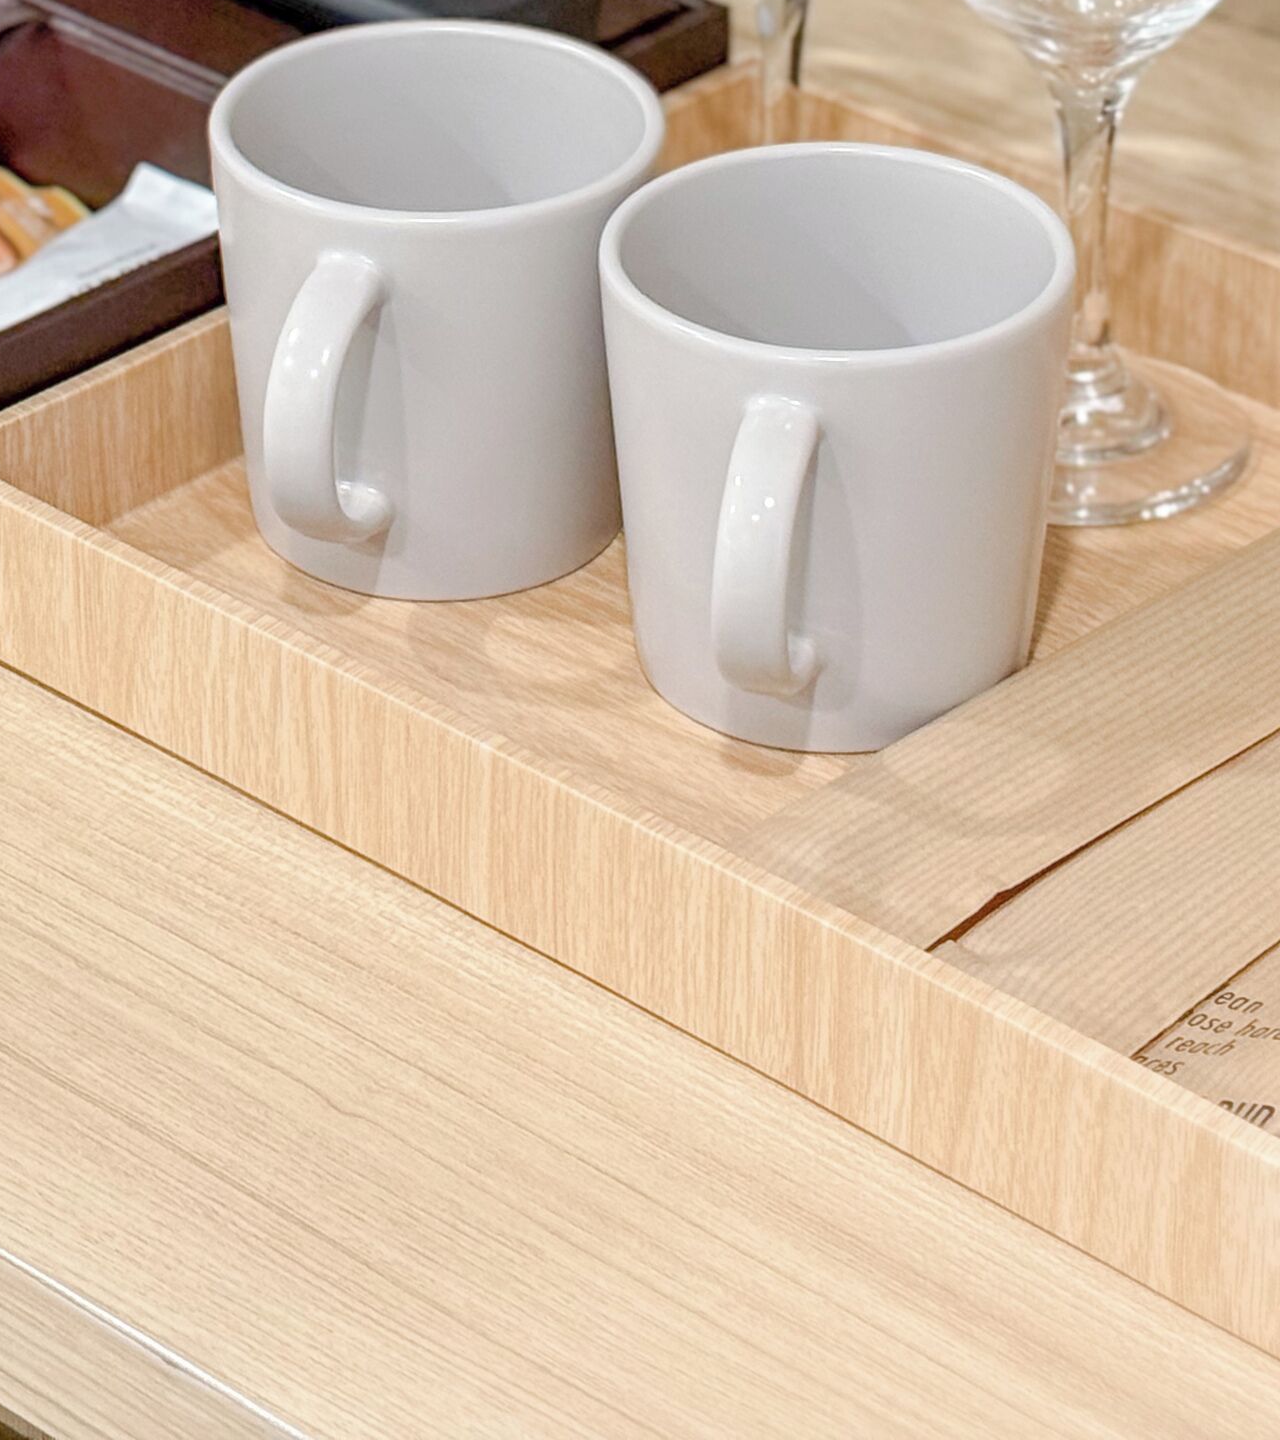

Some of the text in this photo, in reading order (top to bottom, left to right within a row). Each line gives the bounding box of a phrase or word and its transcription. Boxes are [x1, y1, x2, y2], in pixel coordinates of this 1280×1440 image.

[1214, 989, 1265, 1015] ean
[1186, 1010, 1235, 1035] ose
[1164, 1034, 1236, 1058] reach
